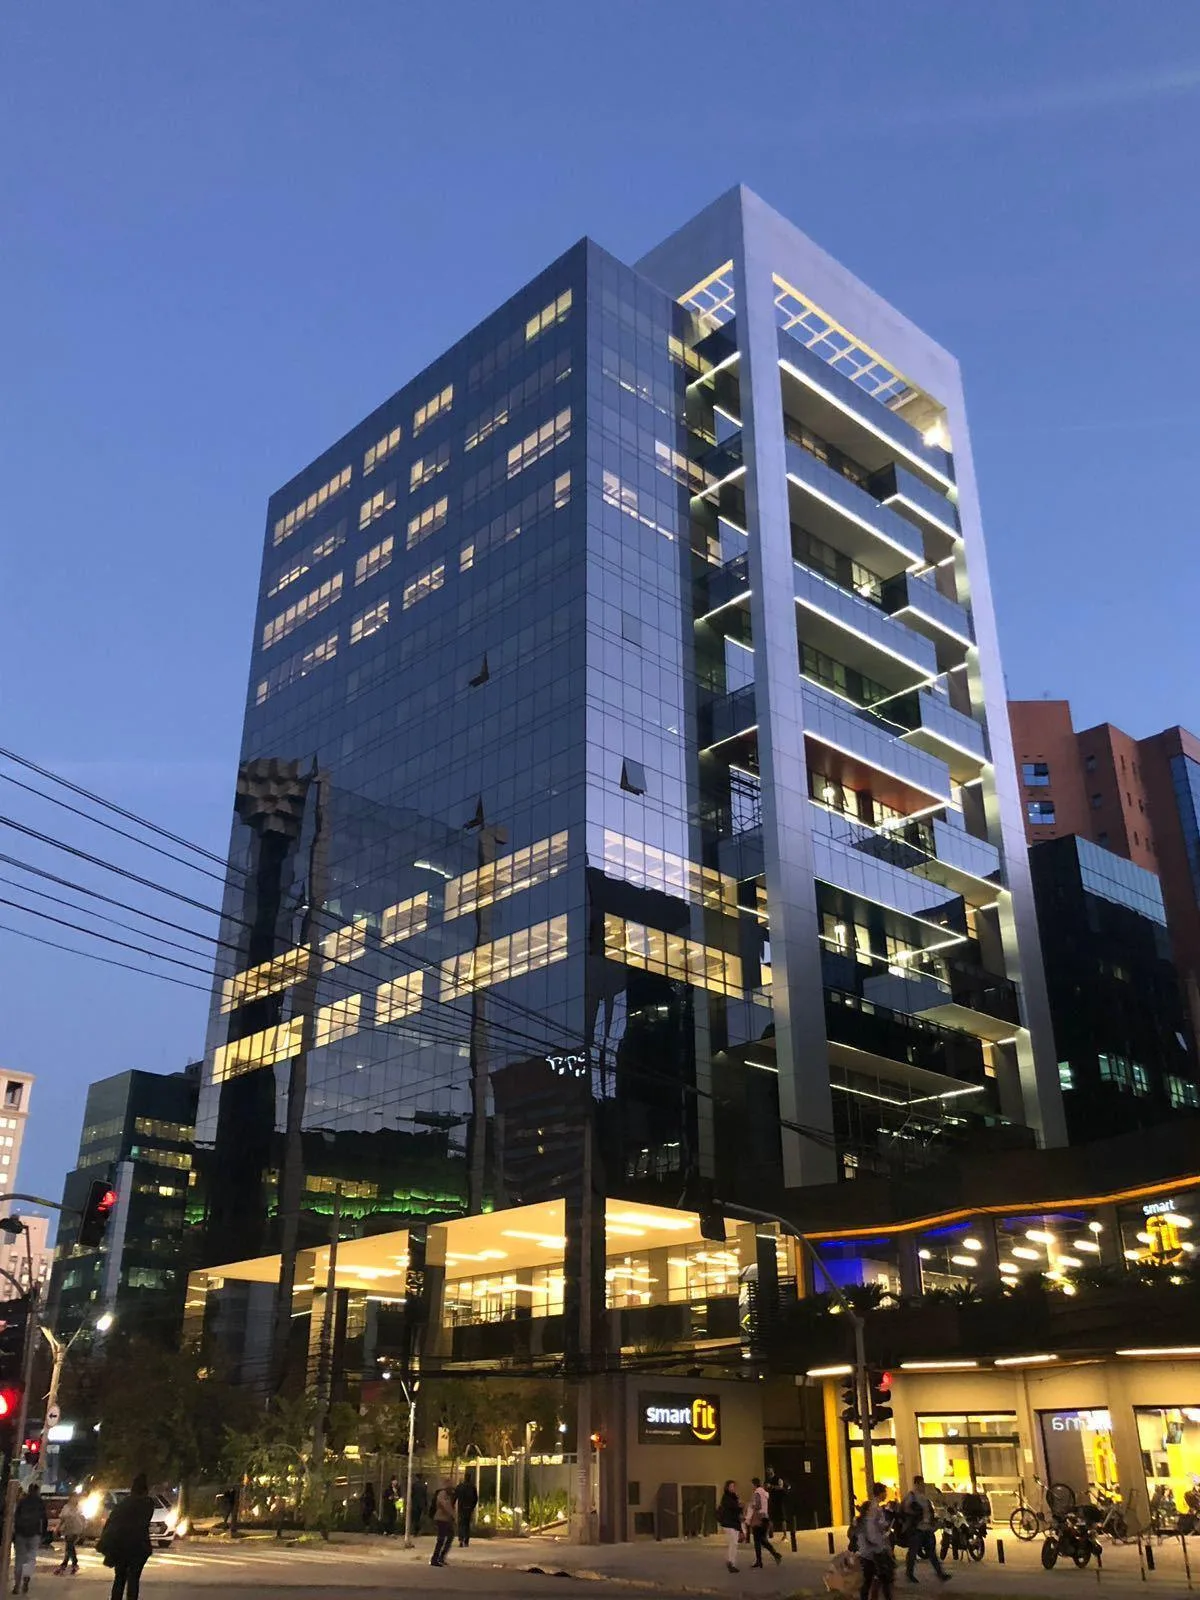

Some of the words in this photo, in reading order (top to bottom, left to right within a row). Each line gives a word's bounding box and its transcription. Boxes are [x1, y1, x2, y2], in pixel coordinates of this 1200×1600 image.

[1143, 1200, 1175, 1215] smart
[646, 1407, 691, 1424] smart
[692, 1398, 716, 1429] fit
